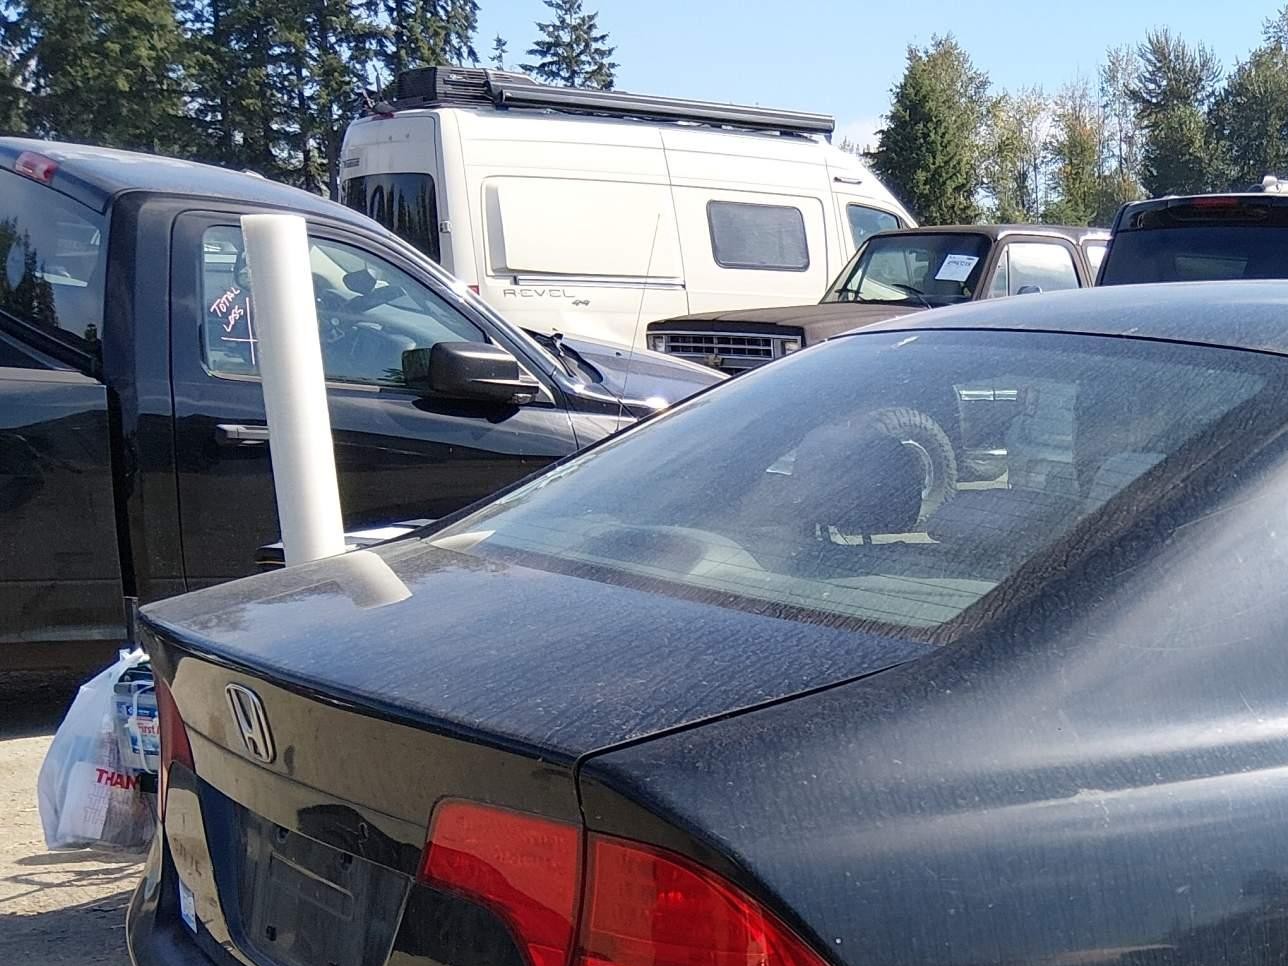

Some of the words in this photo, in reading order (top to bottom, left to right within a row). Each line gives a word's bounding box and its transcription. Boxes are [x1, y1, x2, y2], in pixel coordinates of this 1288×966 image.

[209, 287, 241, 317] TOTAL
[502, 288, 576, 298] REVEL
[222, 304, 244, 333] LOSS
